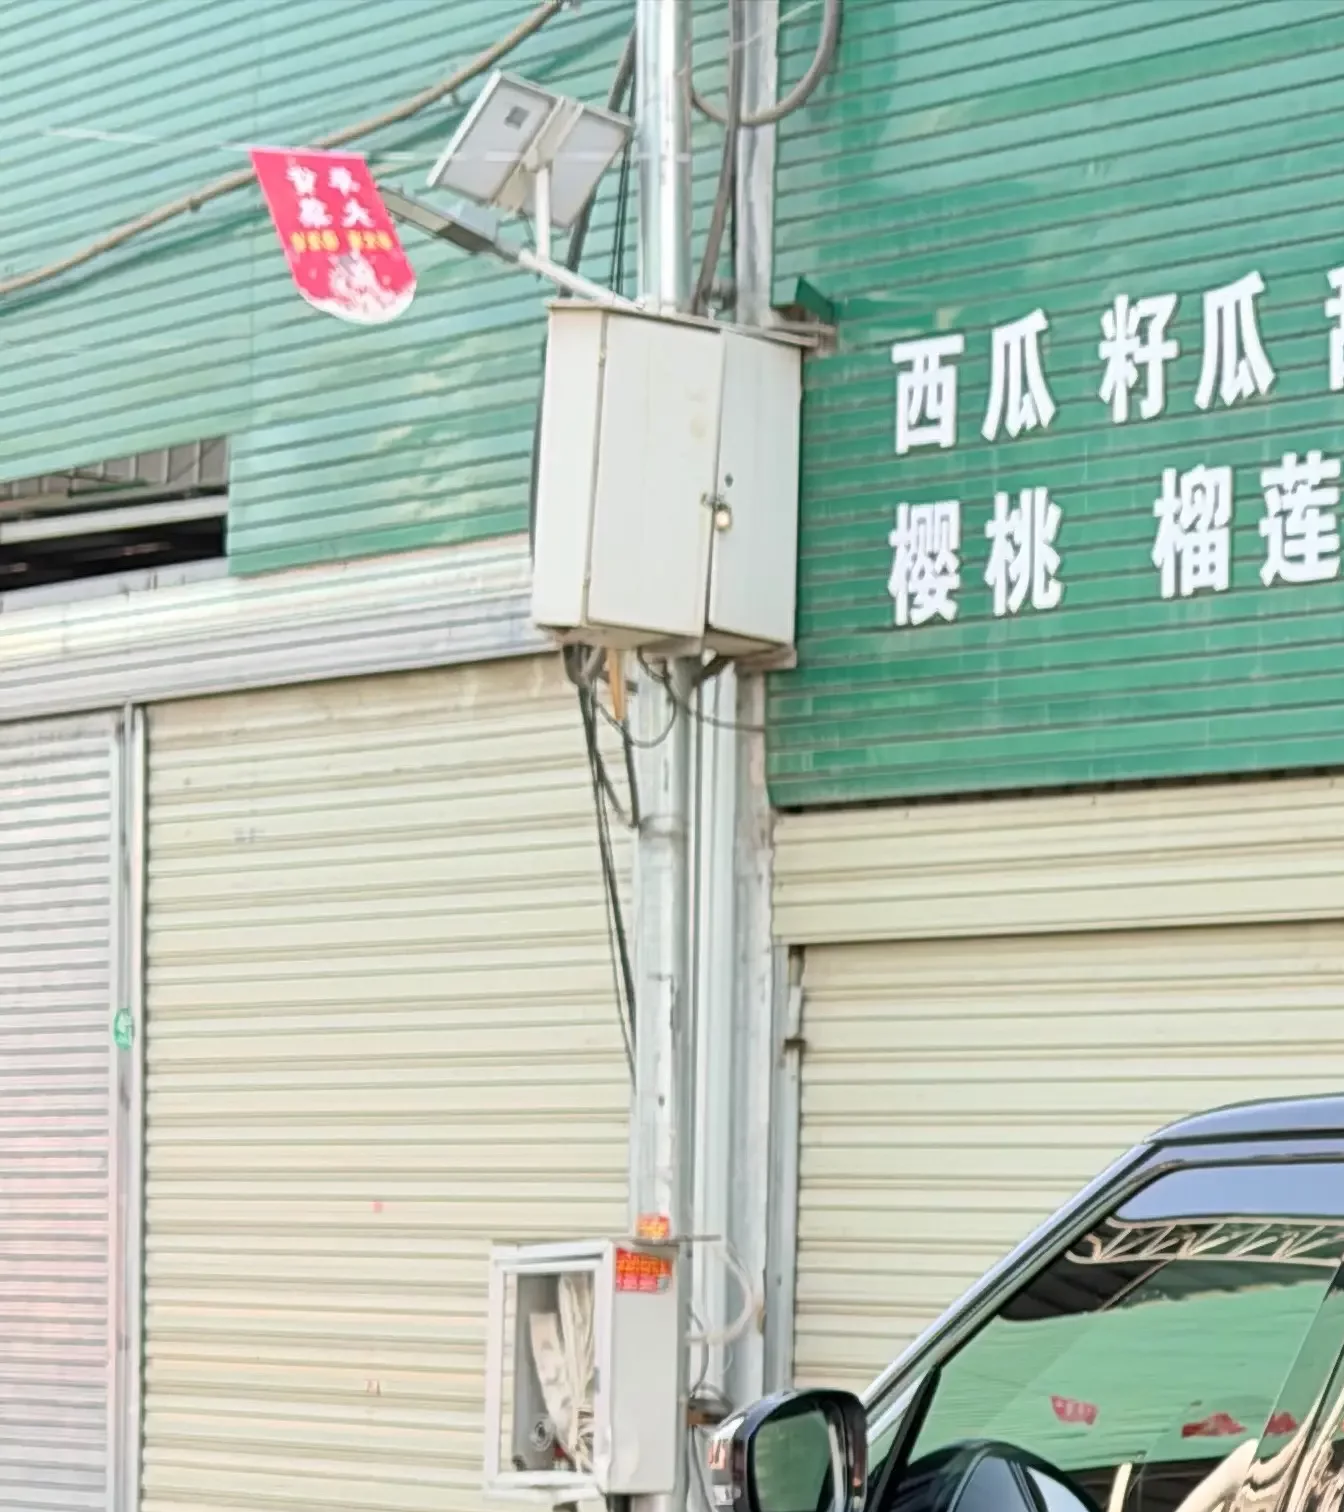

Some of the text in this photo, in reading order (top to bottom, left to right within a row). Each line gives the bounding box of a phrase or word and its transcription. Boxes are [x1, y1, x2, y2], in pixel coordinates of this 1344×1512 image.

[891, 310, 1056, 455] 西瓜
[1098, 272, 1276, 424] 籽瓜
[888, 487, 1063, 627] 樱桃
[1152, 451, 1342, 599] 榴莲
